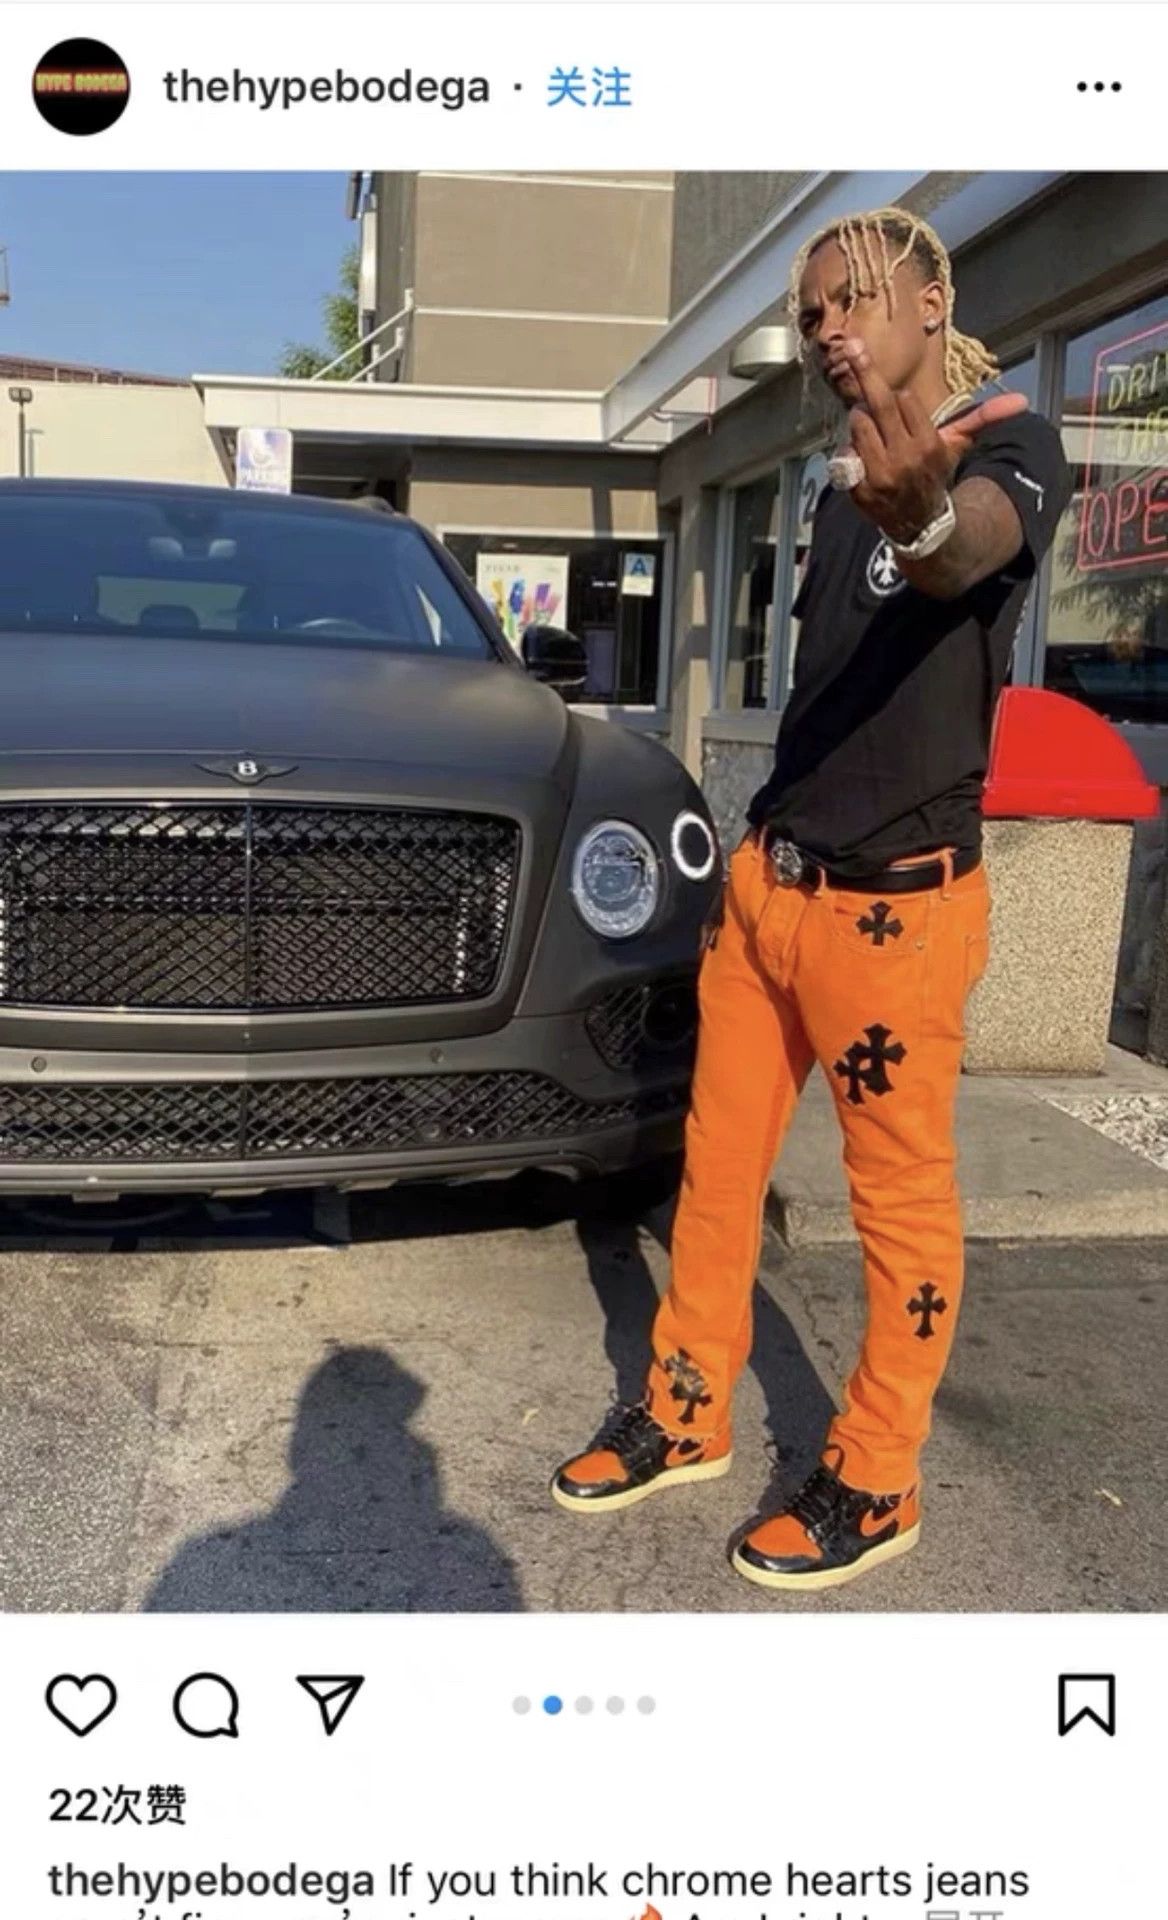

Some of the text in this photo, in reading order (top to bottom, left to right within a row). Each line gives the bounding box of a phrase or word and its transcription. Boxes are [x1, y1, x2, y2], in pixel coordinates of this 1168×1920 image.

[1108, 354, 1168, 411] DRI
[631, 557, 648, 576] A
[238, 760, 257, 776] B
